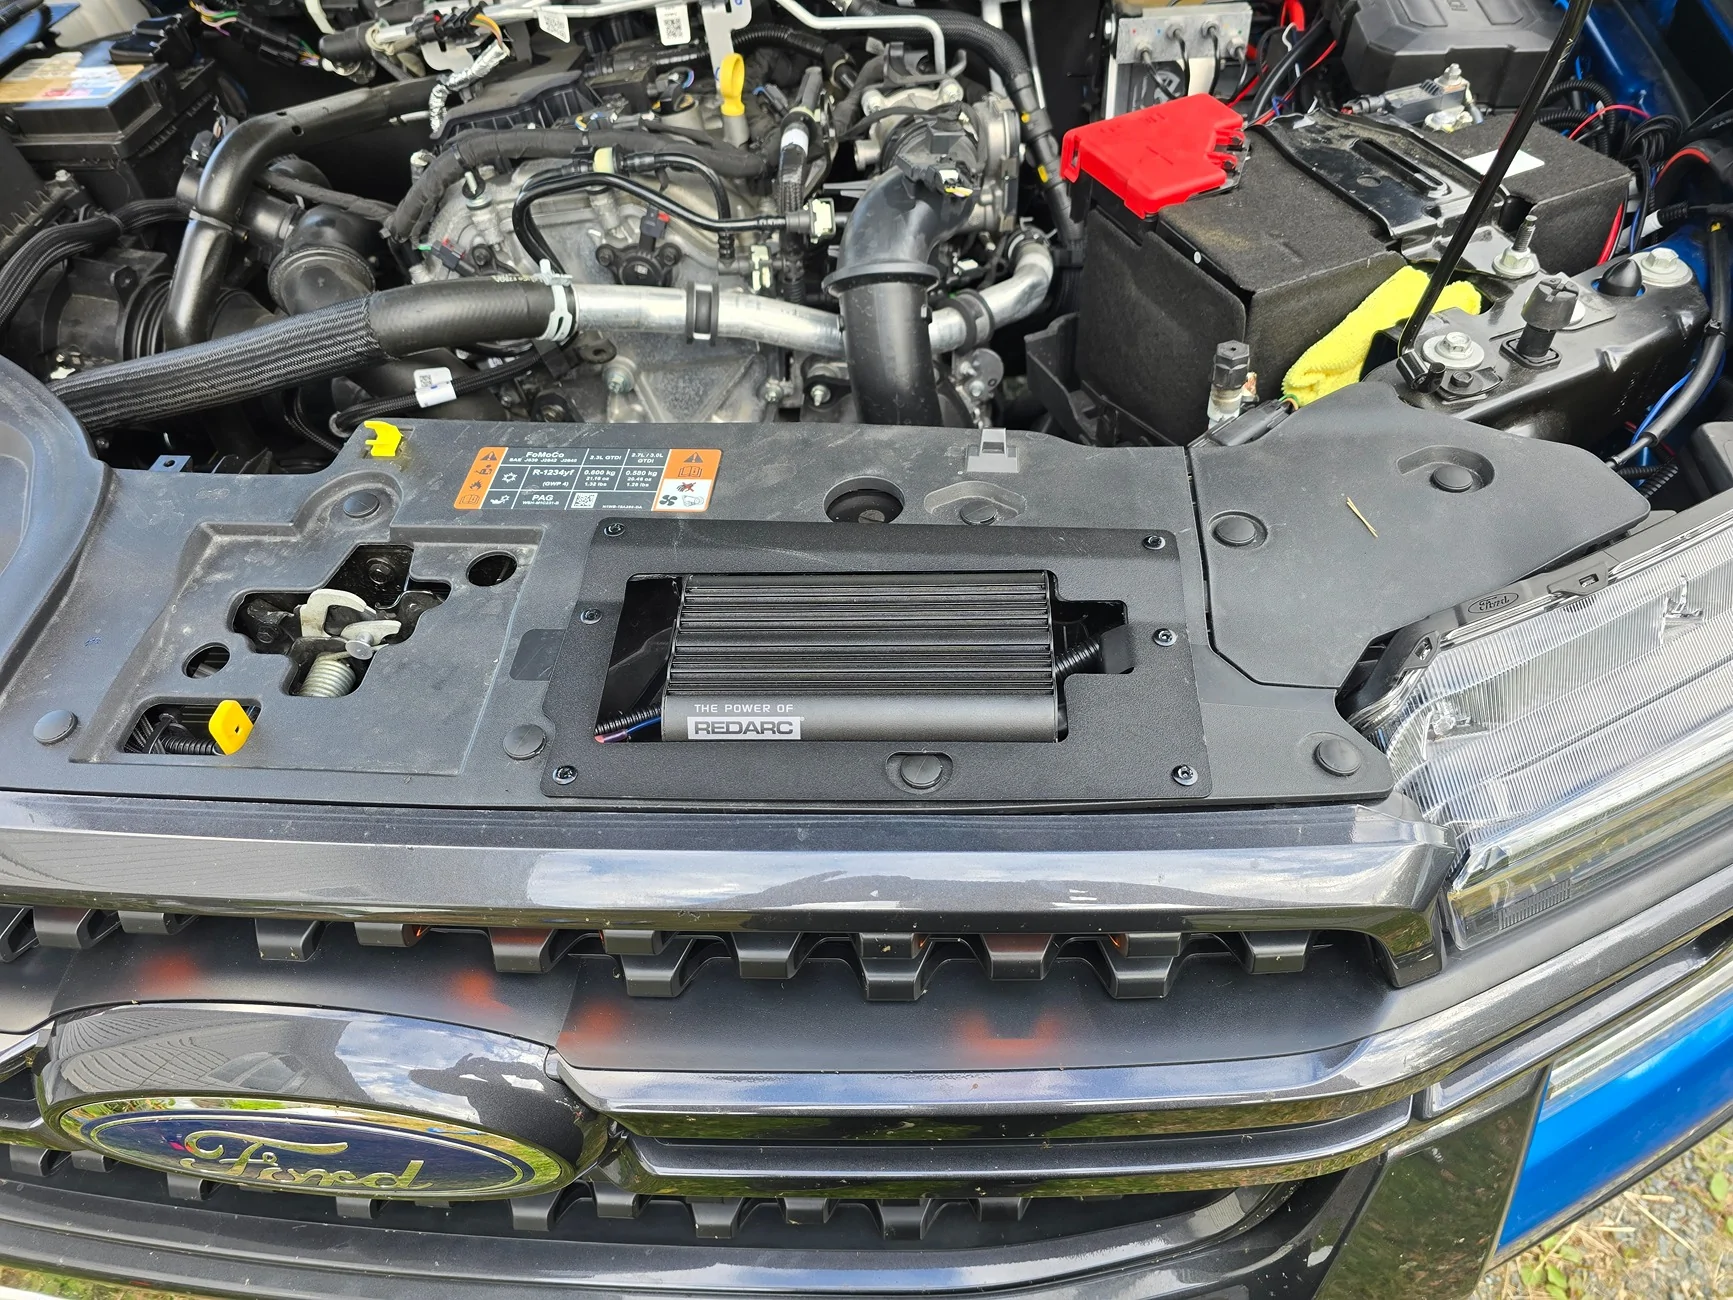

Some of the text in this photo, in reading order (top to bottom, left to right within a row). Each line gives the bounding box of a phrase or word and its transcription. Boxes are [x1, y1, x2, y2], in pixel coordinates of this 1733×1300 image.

[532, 469, 575, 477] R-1234yf
[1478, 595, 1510, 611] Ford
[694, 704, 794, 713] THE POWER OF
[693, 720, 795, 736] REDARC
[179, 1129, 433, 1190] Ford
